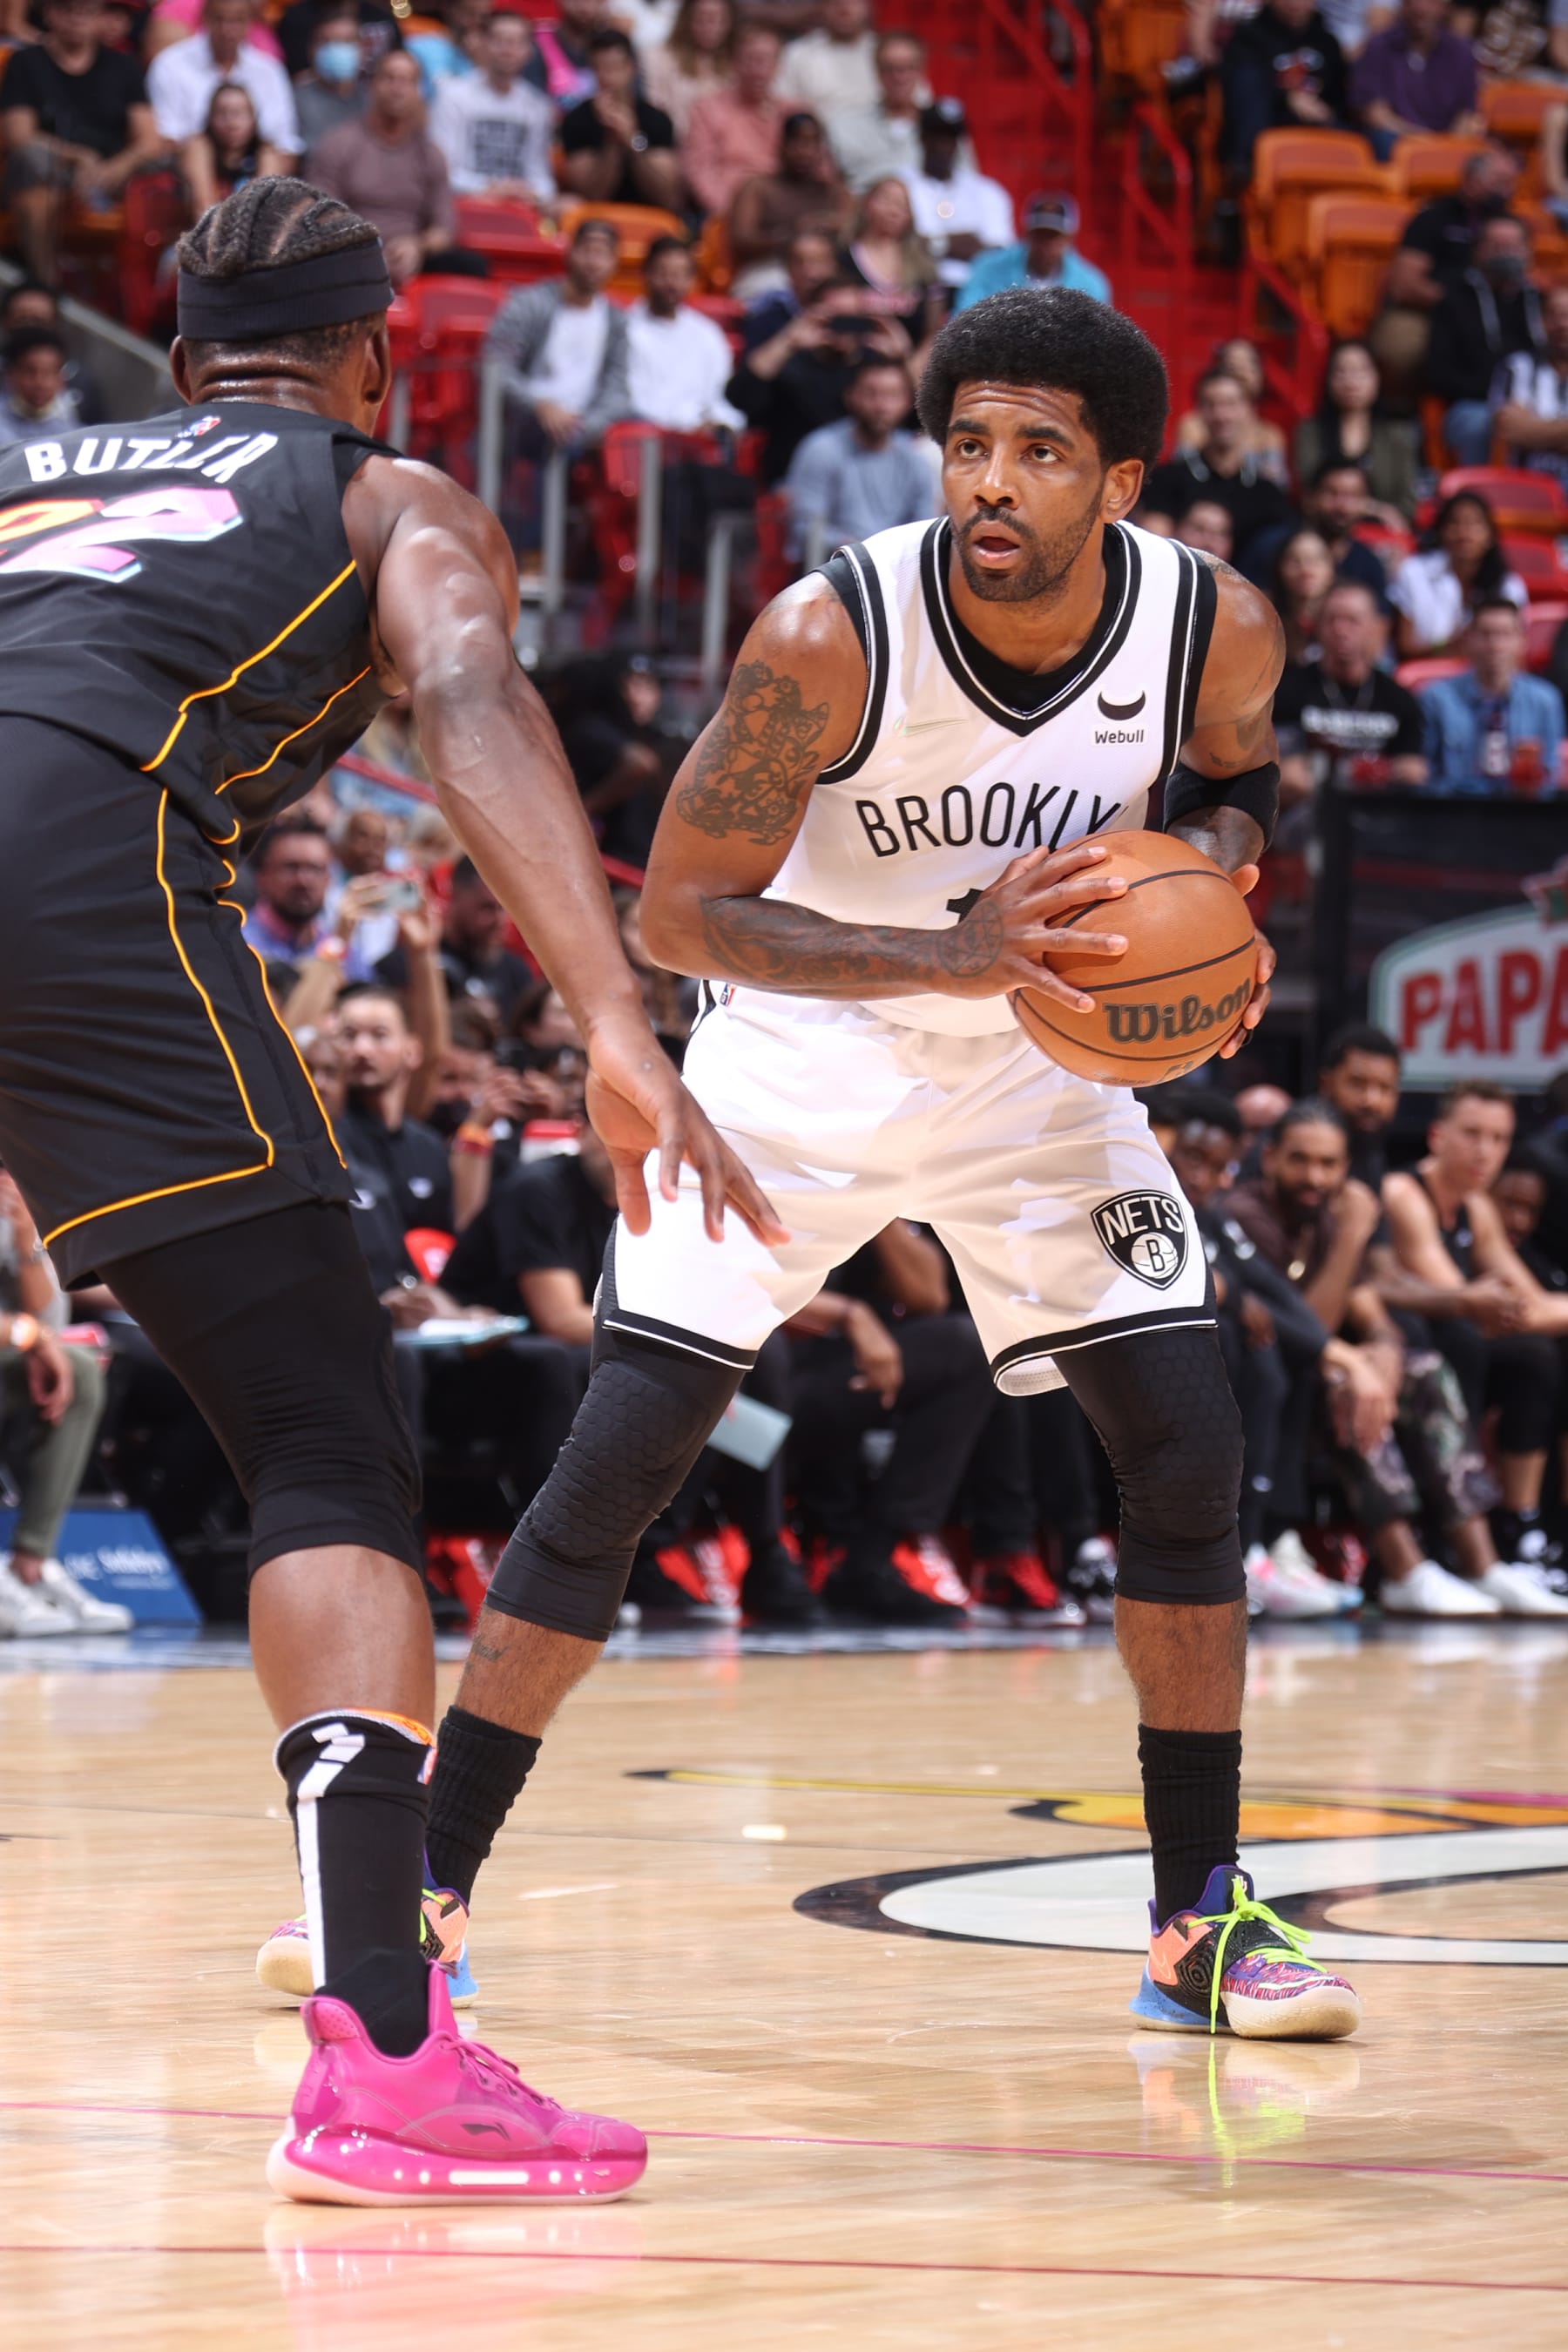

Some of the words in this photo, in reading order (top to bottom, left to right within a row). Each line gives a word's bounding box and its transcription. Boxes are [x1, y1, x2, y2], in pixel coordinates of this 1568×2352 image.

[24, 432, 279, 483] BUTLER
[1094, 728, 1145, 745] Webull
[855, 781, 1130, 858] BROOKLY
[1103, 977, 1251, 1045] Wilson
[1101, 1196, 1185, 1246] NETS
[1146, 1239, 1166, 1273] B
